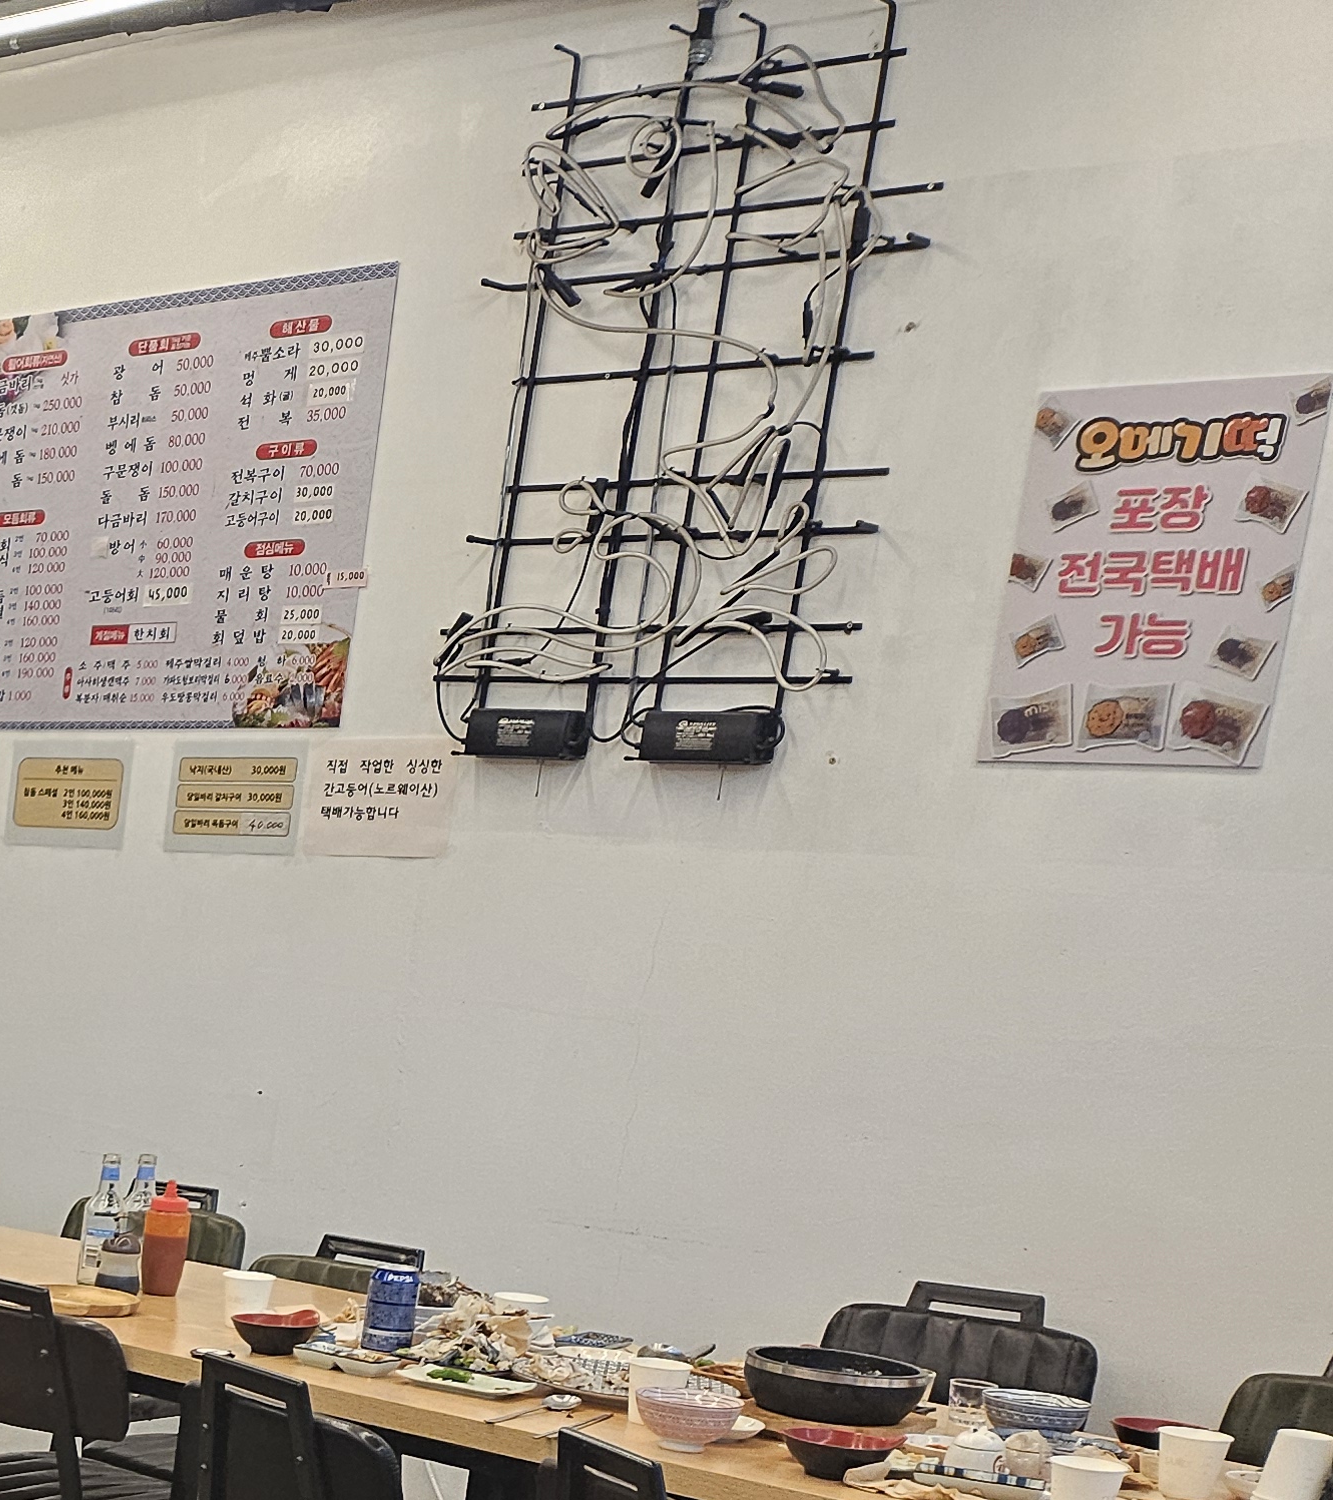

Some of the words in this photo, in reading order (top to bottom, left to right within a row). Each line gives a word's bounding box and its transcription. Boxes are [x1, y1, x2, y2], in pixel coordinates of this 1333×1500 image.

[312, 335, 365, 355] 30,000
[308, 359, 360, 378] 20,000
[312, 384, 348, 400] 20,000
[1078, 414, 1284, 470] 오메기떡
[295, 485, 334, 500] 30,000
[293, 508, 333, 524] 20,000
[1109, 484, 1211, 532] 포장
[335, 570, 366, 583] 15,000
[1057, 547, 1249, 596] 전국택배
[148, 585, 189, 602] 45,000
[283, 608, 321, 622] 25,000
[281, 628, 317, 642] 20,000
[1093, 612, 1192, 659] 가능
[326, 759, 349, 775] 직접
[359, 759, 395, 775] 작업한
[406, 759, 443, 775] 싱싱한
[323, 781, 439, 799] 간고등어(노르웨이산)
[320, 805, 400, 821] 택배가능합니다
